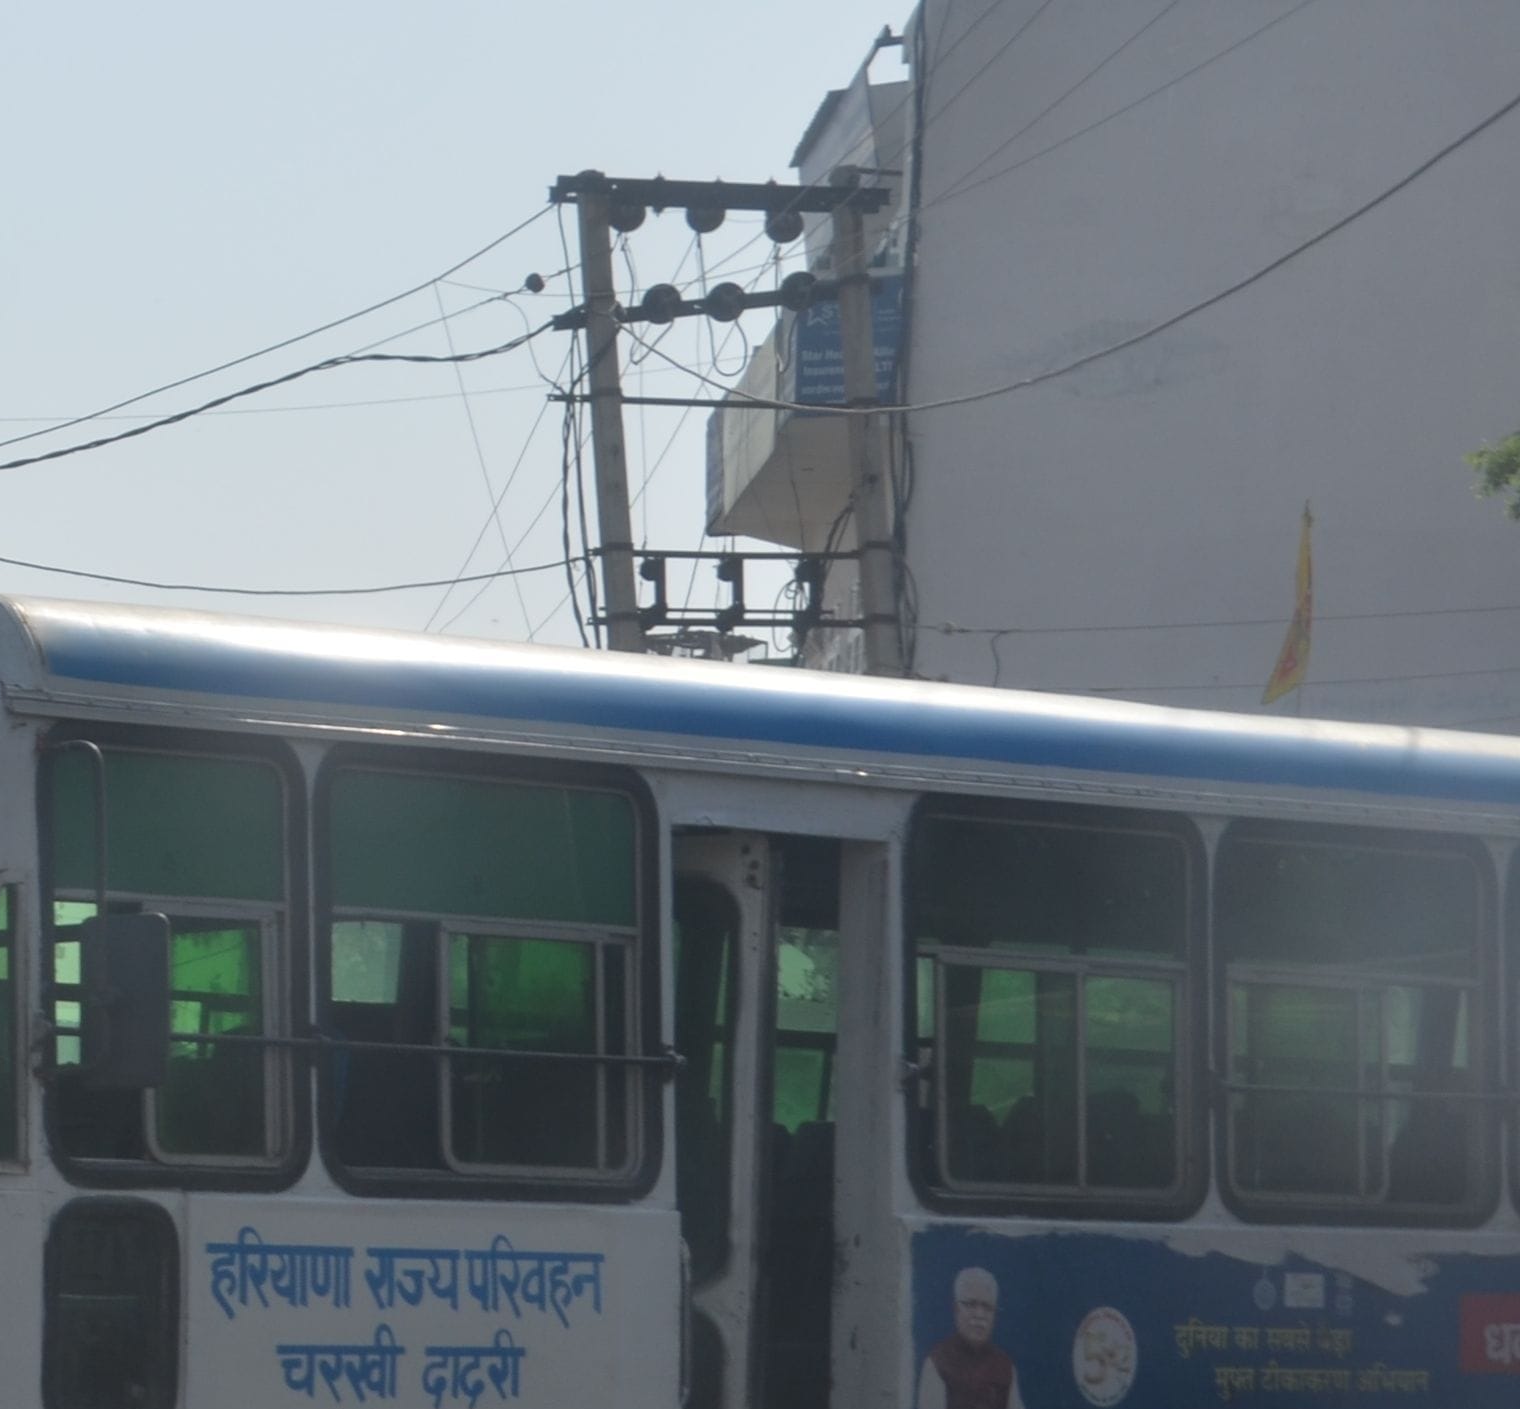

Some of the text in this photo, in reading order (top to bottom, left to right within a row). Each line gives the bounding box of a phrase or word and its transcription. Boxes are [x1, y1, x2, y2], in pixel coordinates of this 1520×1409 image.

[205, 1226, 606, 1328] हरियाणा राज्य परिवहन
[277, 1323, 406, 1405] चरखी
[1173, 1316, 1230, 1361] दुनिया
[1234, 1325, 1260, 1351] का
[1266, 1319, 1312, 1351] सबसे
[1261, 1360, 1351, 1393] टीकाकरण
[1359, 1360, 1431, 1394] अभियान
